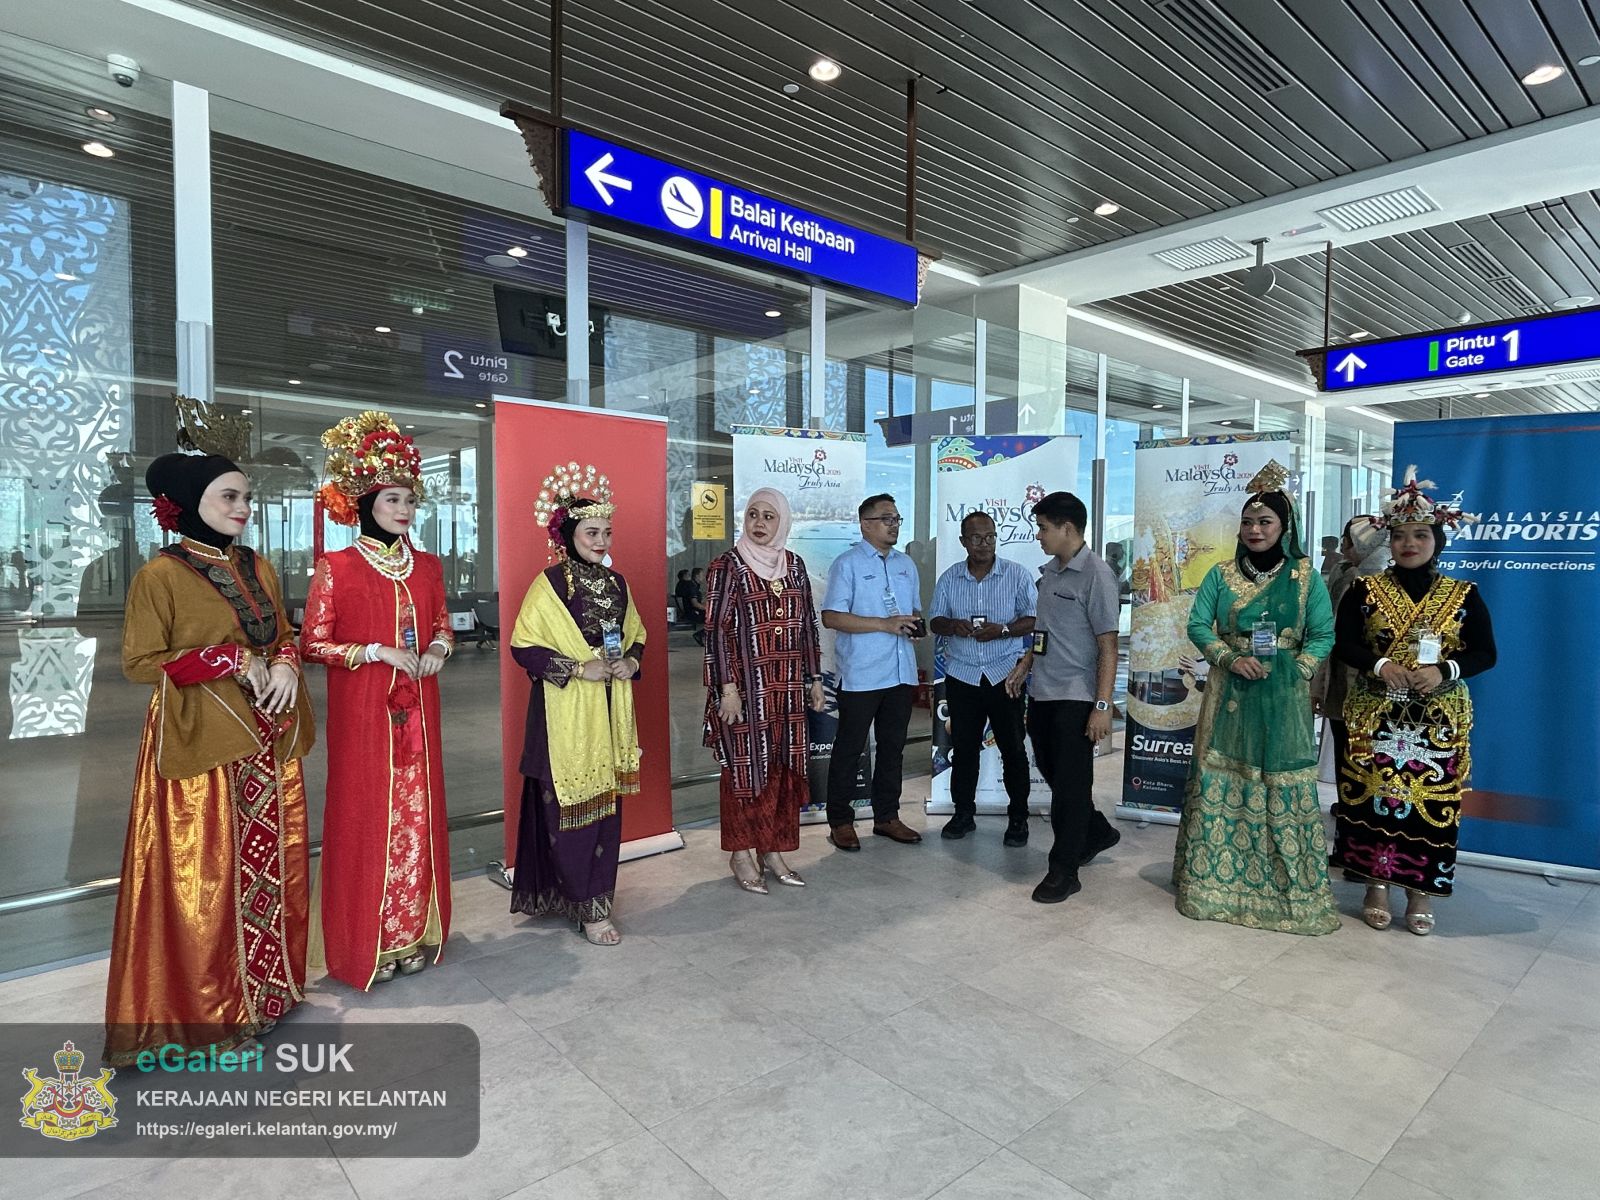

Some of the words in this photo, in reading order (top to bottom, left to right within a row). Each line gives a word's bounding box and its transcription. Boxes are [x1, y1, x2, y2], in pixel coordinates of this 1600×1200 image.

[730, 194, 776, 229] Balai
[780, 211, 855, 255] Ketibaan
[729, 224, 781, 255] Arrival
[784, 240, 812, 264] Hall
[1446, 334, 1496, 353] Pintu
[1502, 329, 1519, 362] 1
[1445, 353, 1485, 368] Gate
[764, 458, 826, 475] Malaysia
[1165, 463, 1237, 482] Malaysia
[798, 475, 823, 490] Truly
[824, 480, 841, 488] Asia
[1202, 481, 1232, 496] Truly
[1454, 523, 1600, 541] AIRPORTS
[1458, 559, 1501, 570] Joyful
[1504, 560, 1596, 571] Connections
[1131, 734, 1194, 756] Surrea
